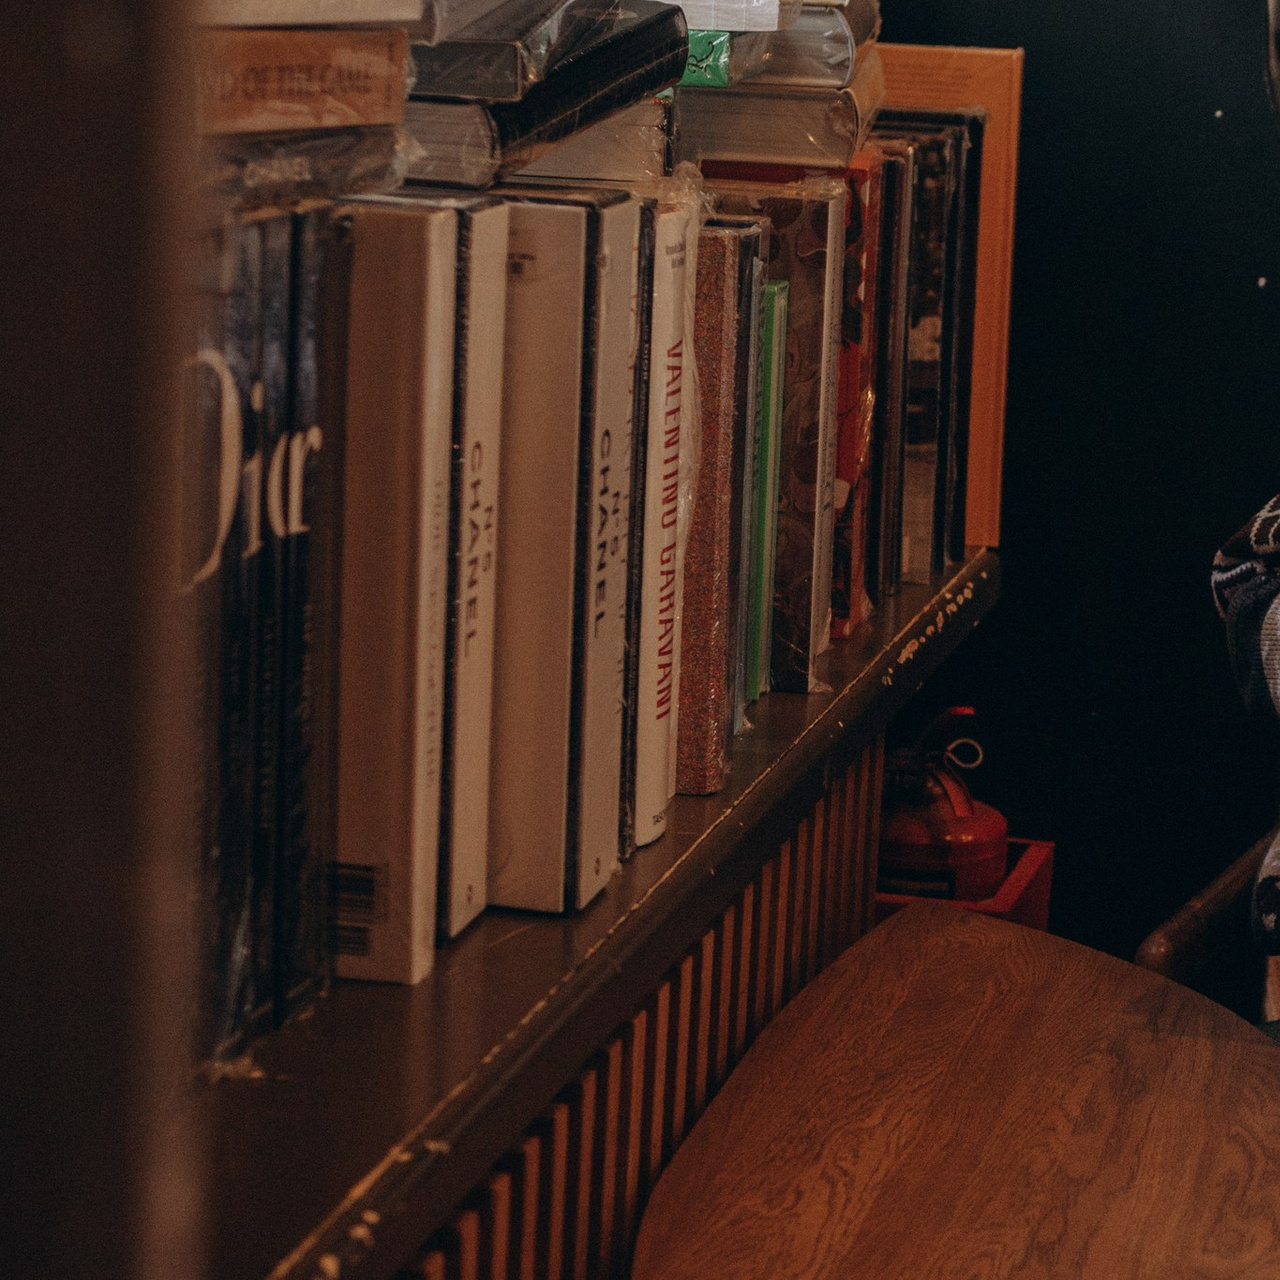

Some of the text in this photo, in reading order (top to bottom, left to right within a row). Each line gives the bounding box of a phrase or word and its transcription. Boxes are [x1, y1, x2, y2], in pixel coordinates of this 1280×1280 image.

[464, 440, 484, 658] CHANEL
[594, 428, 612, 639] CHANEL
[655, 338, 684, 721] VALENTINO GARAVANI
